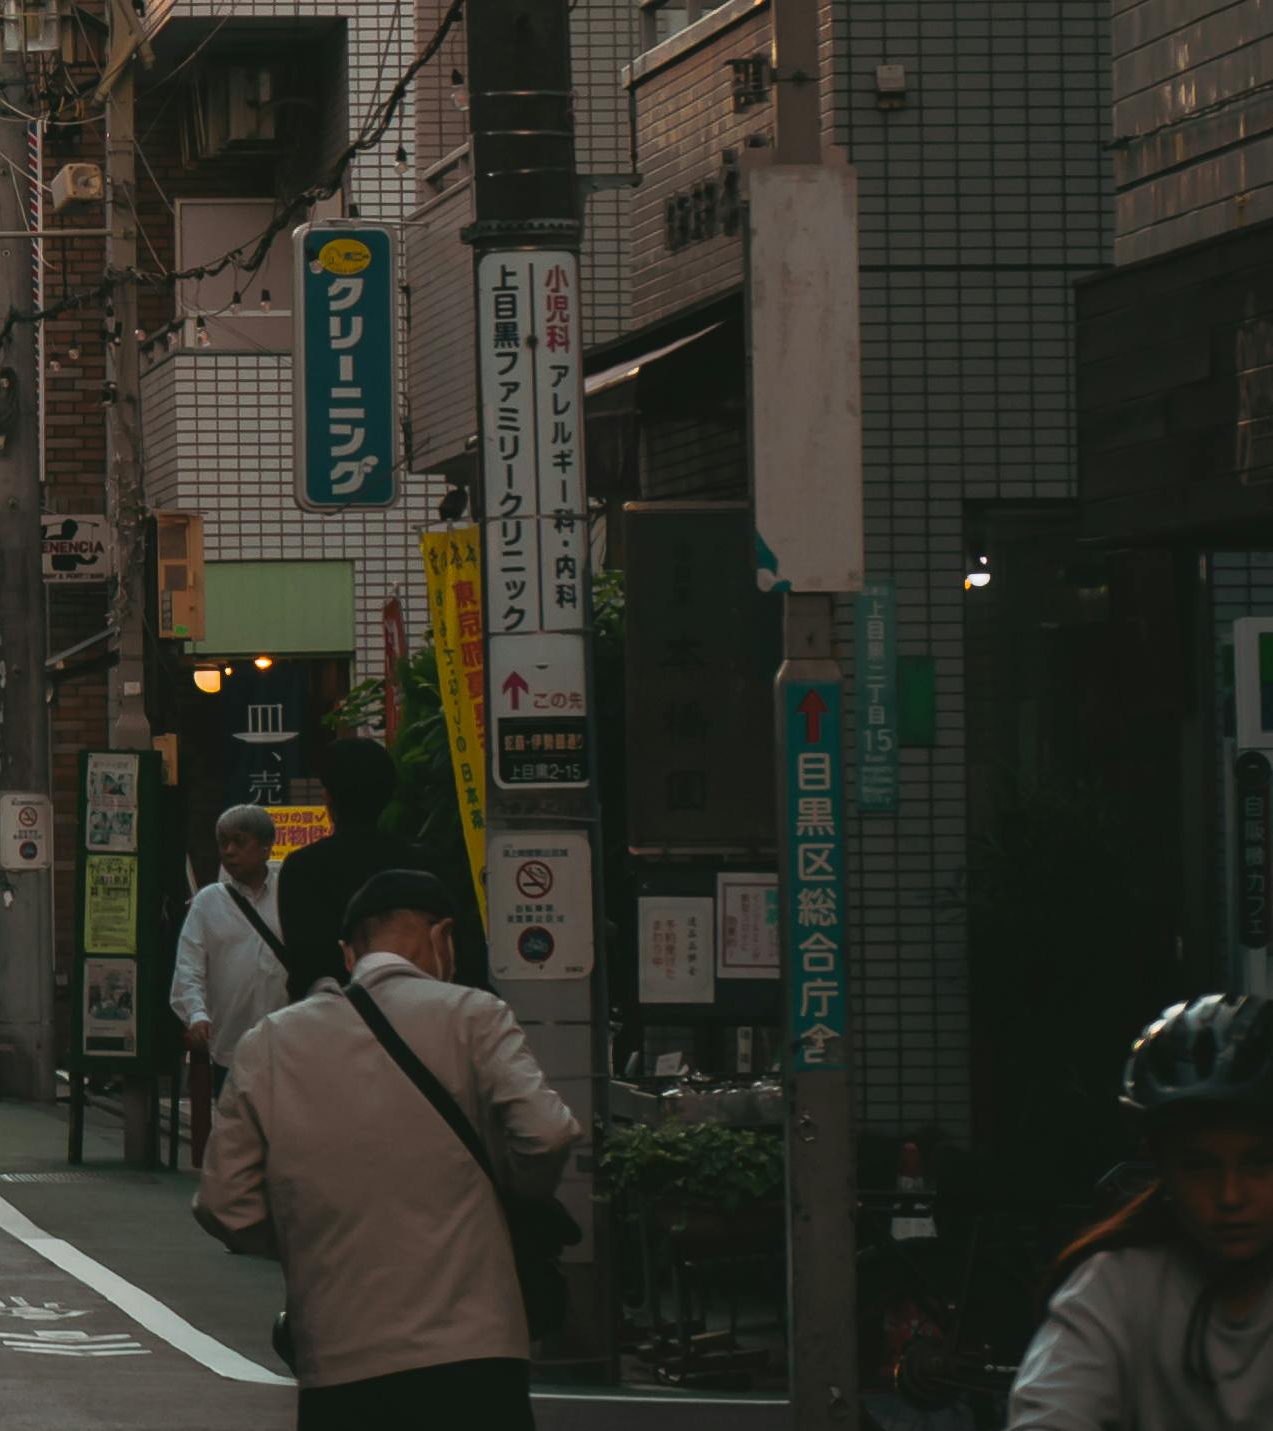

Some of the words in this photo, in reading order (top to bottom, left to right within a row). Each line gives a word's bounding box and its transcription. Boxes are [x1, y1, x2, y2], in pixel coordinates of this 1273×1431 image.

[327, 277, 380, 496] クリーニング
[545, 264, 571, 354] 小児科
[491, 263, 526, 632] 上目黒ファミリークリニック
[548, 364, 578, 610] アレルギー科・内科
[862, 728, 893, 752] 15
[795, 751, 841, 1064] 目黒区総合庁舎
